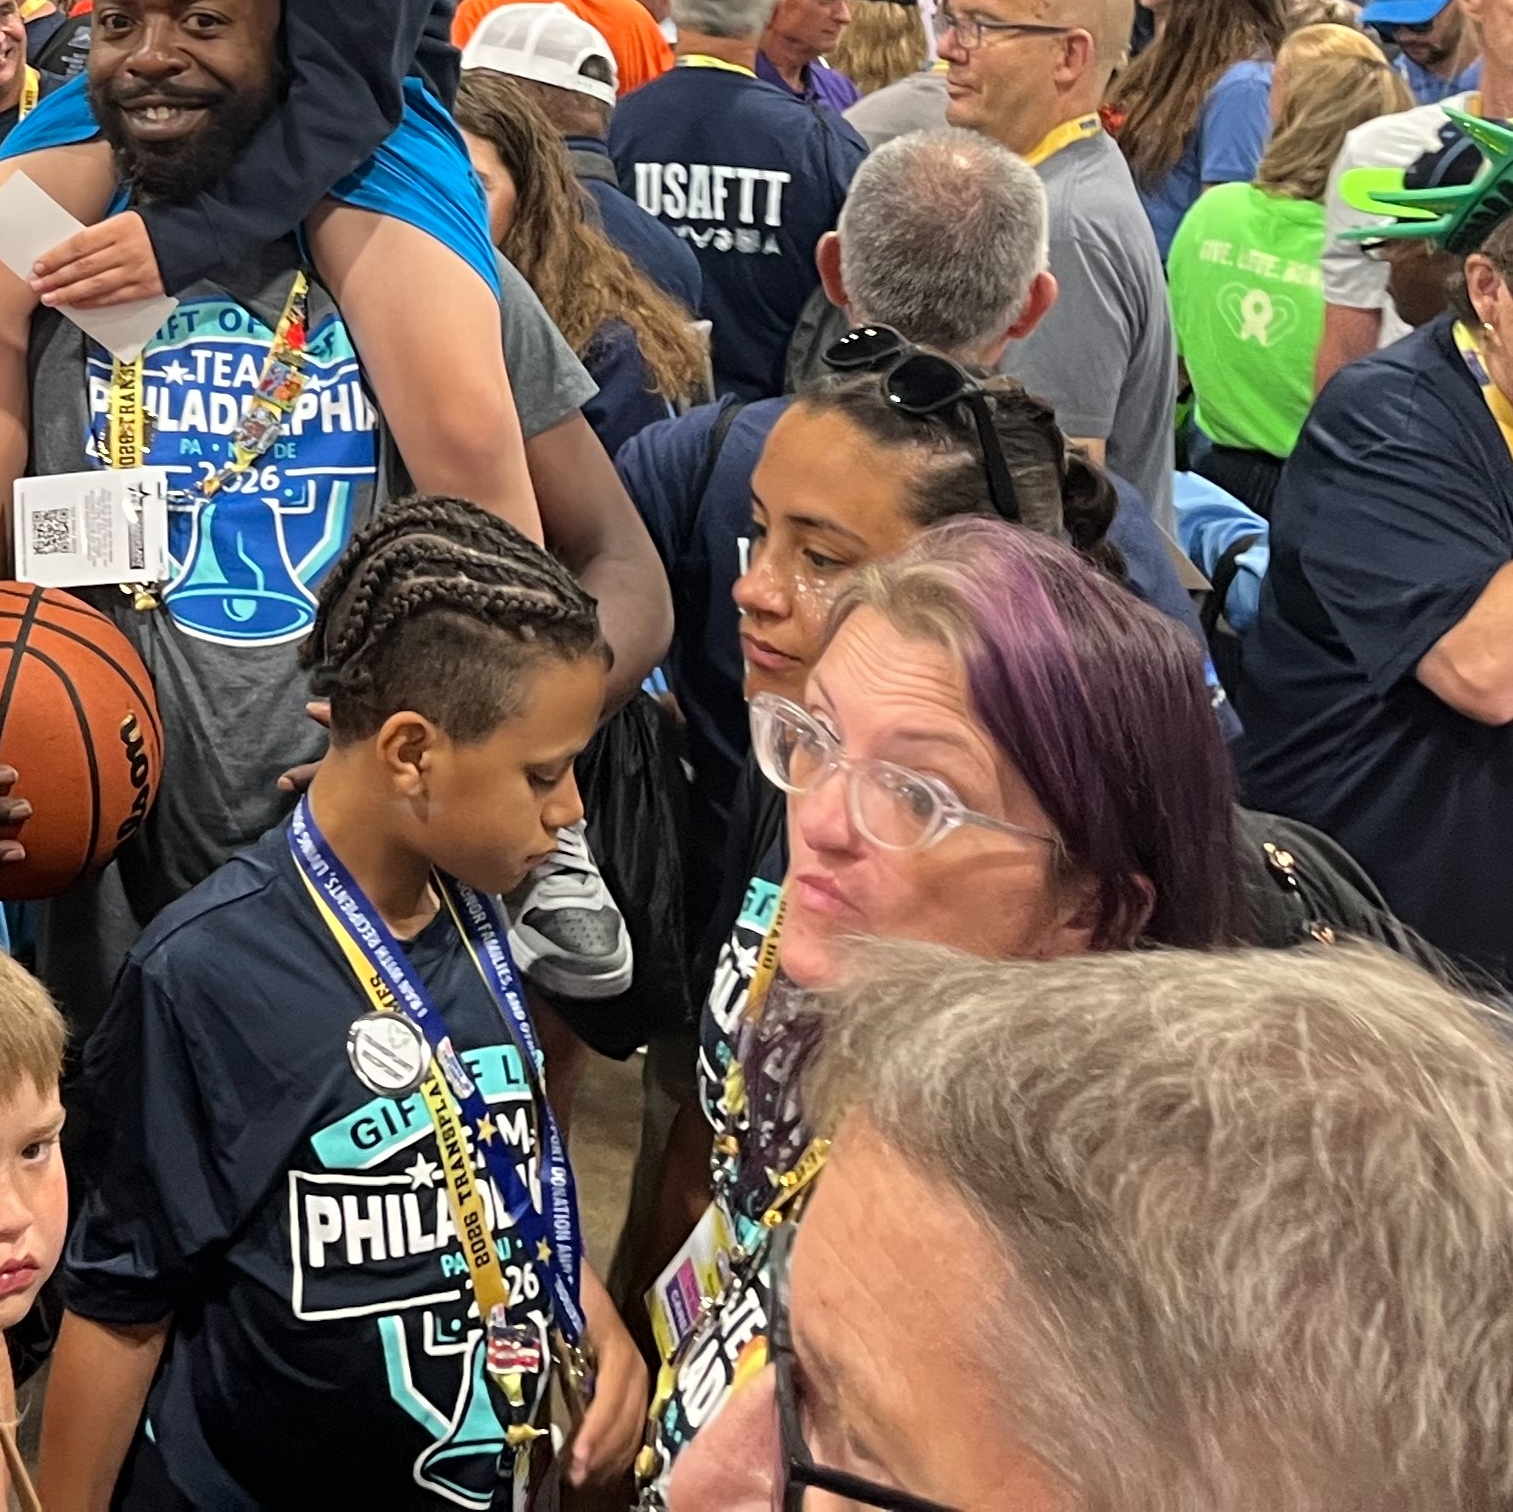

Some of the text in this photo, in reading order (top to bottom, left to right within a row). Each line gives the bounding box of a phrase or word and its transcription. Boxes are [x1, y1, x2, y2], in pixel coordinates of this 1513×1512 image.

[634, 161, 791, 227] USAFTT
[191, 349, 269, 389] TEA
[180, 438, 297, 459] PA DE
[349, 1098, 417, 1150] GIF
[549, 1166, 573, 1241] DONATION
[463, 1212, 491, 1269] 2026
